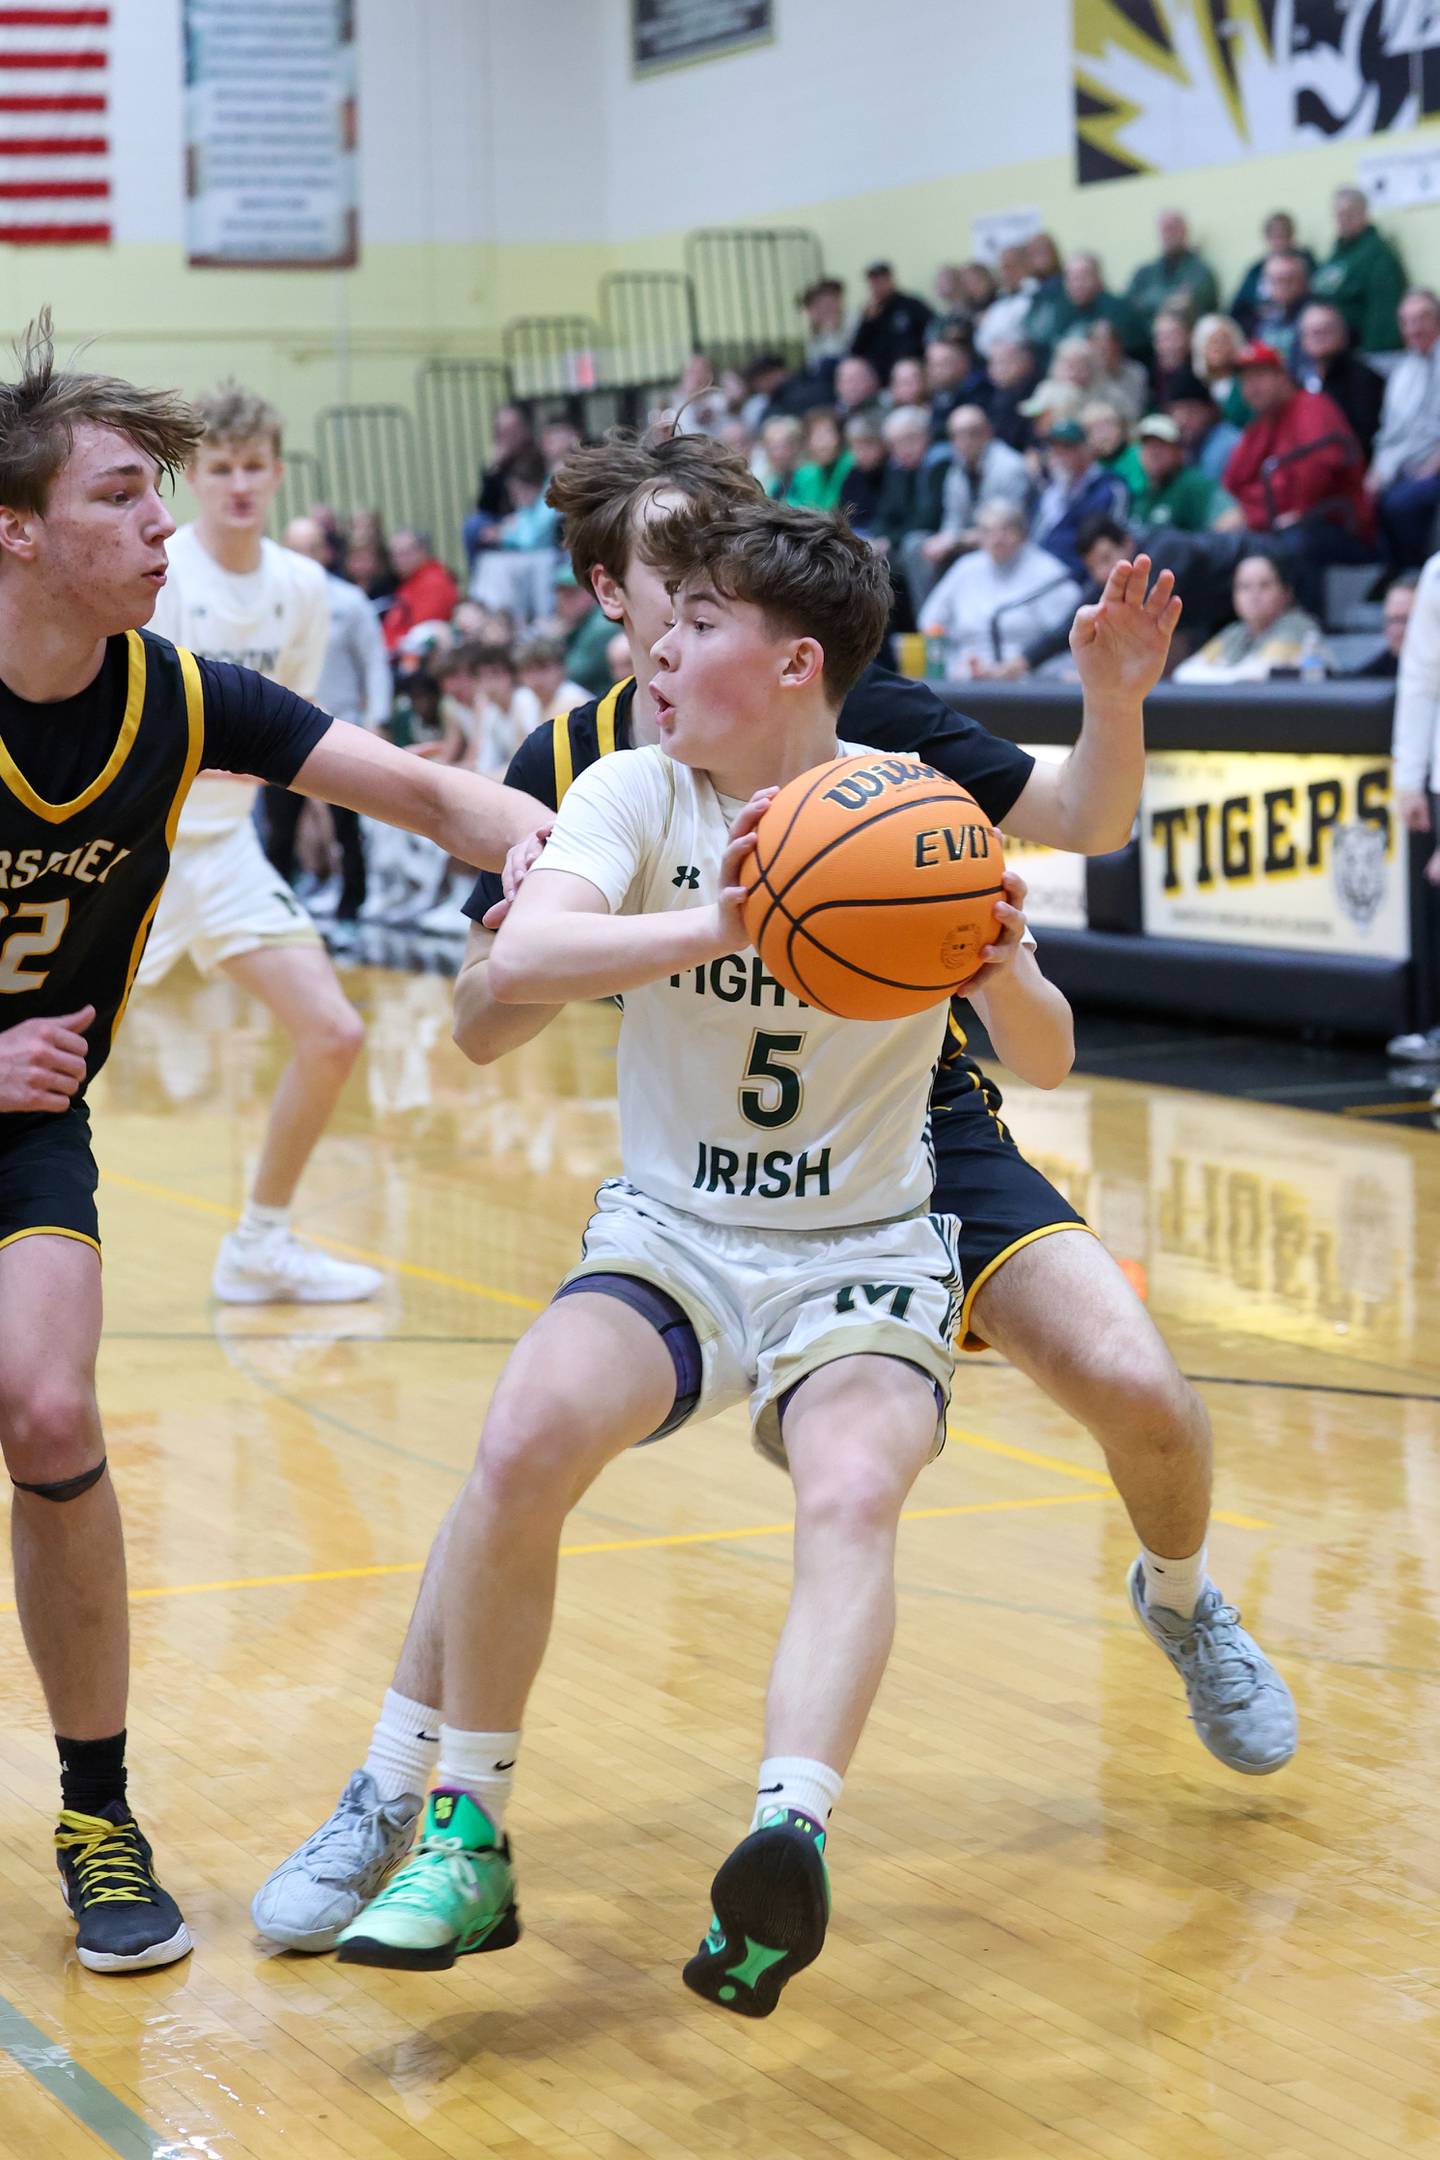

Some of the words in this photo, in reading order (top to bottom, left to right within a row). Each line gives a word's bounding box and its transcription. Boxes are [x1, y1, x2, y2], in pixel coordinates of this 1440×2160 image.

[1152, 769, 1392, 894] TIGERS
[0, 897, 71, 995] 2
[669, 953, 809, 1008] IGH
[737, 1026, 808, 1132] 5
[692, 1141, 832, 1199] IRISH
